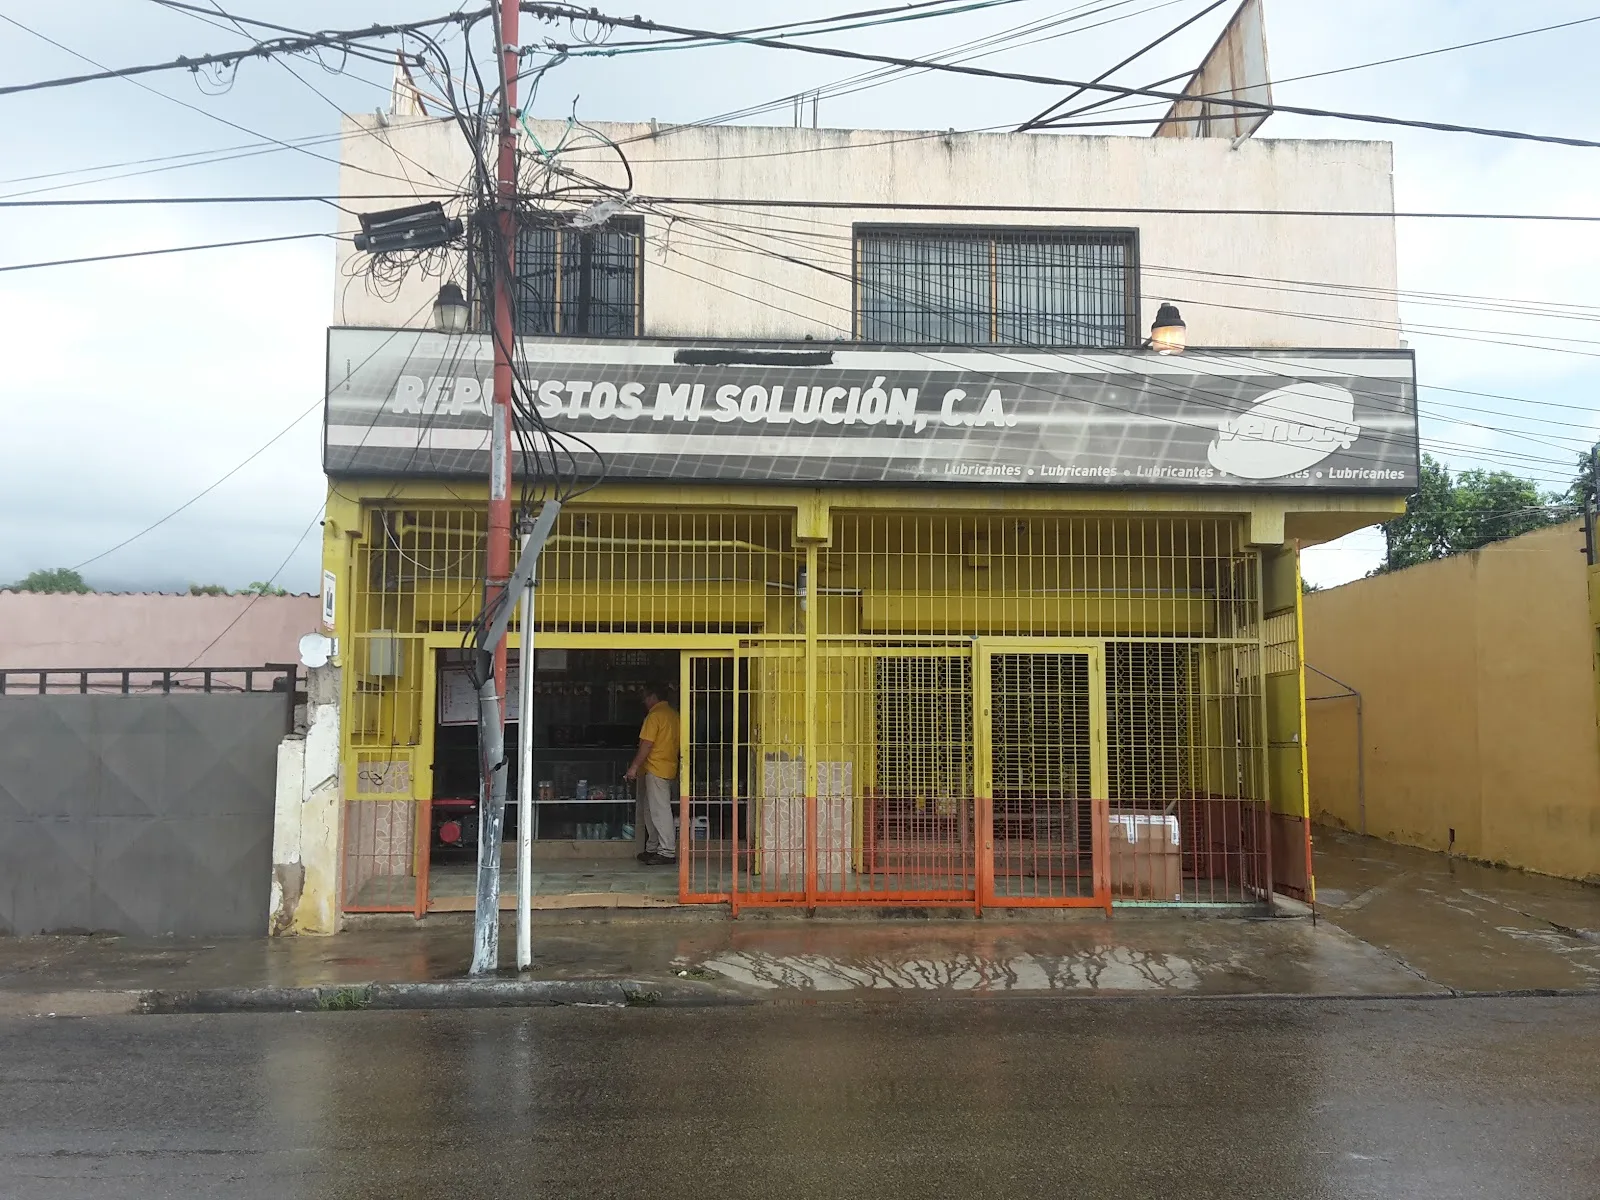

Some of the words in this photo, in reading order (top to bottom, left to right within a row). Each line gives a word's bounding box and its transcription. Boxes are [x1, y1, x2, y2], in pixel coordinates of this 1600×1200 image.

[652, 382, 706, 422] MI
[711, 375, 928, 434] SOLUCIÓN,
[940, 387, 1018, 427] C.A.
[944, 462, 1022, 477] Lubricantes
[1040, 463, 1118, 478] Lubricantes
[1136, 464, 1215, 479] Lubricantes
[1328, 466, 1406, 480] Lubricantes
